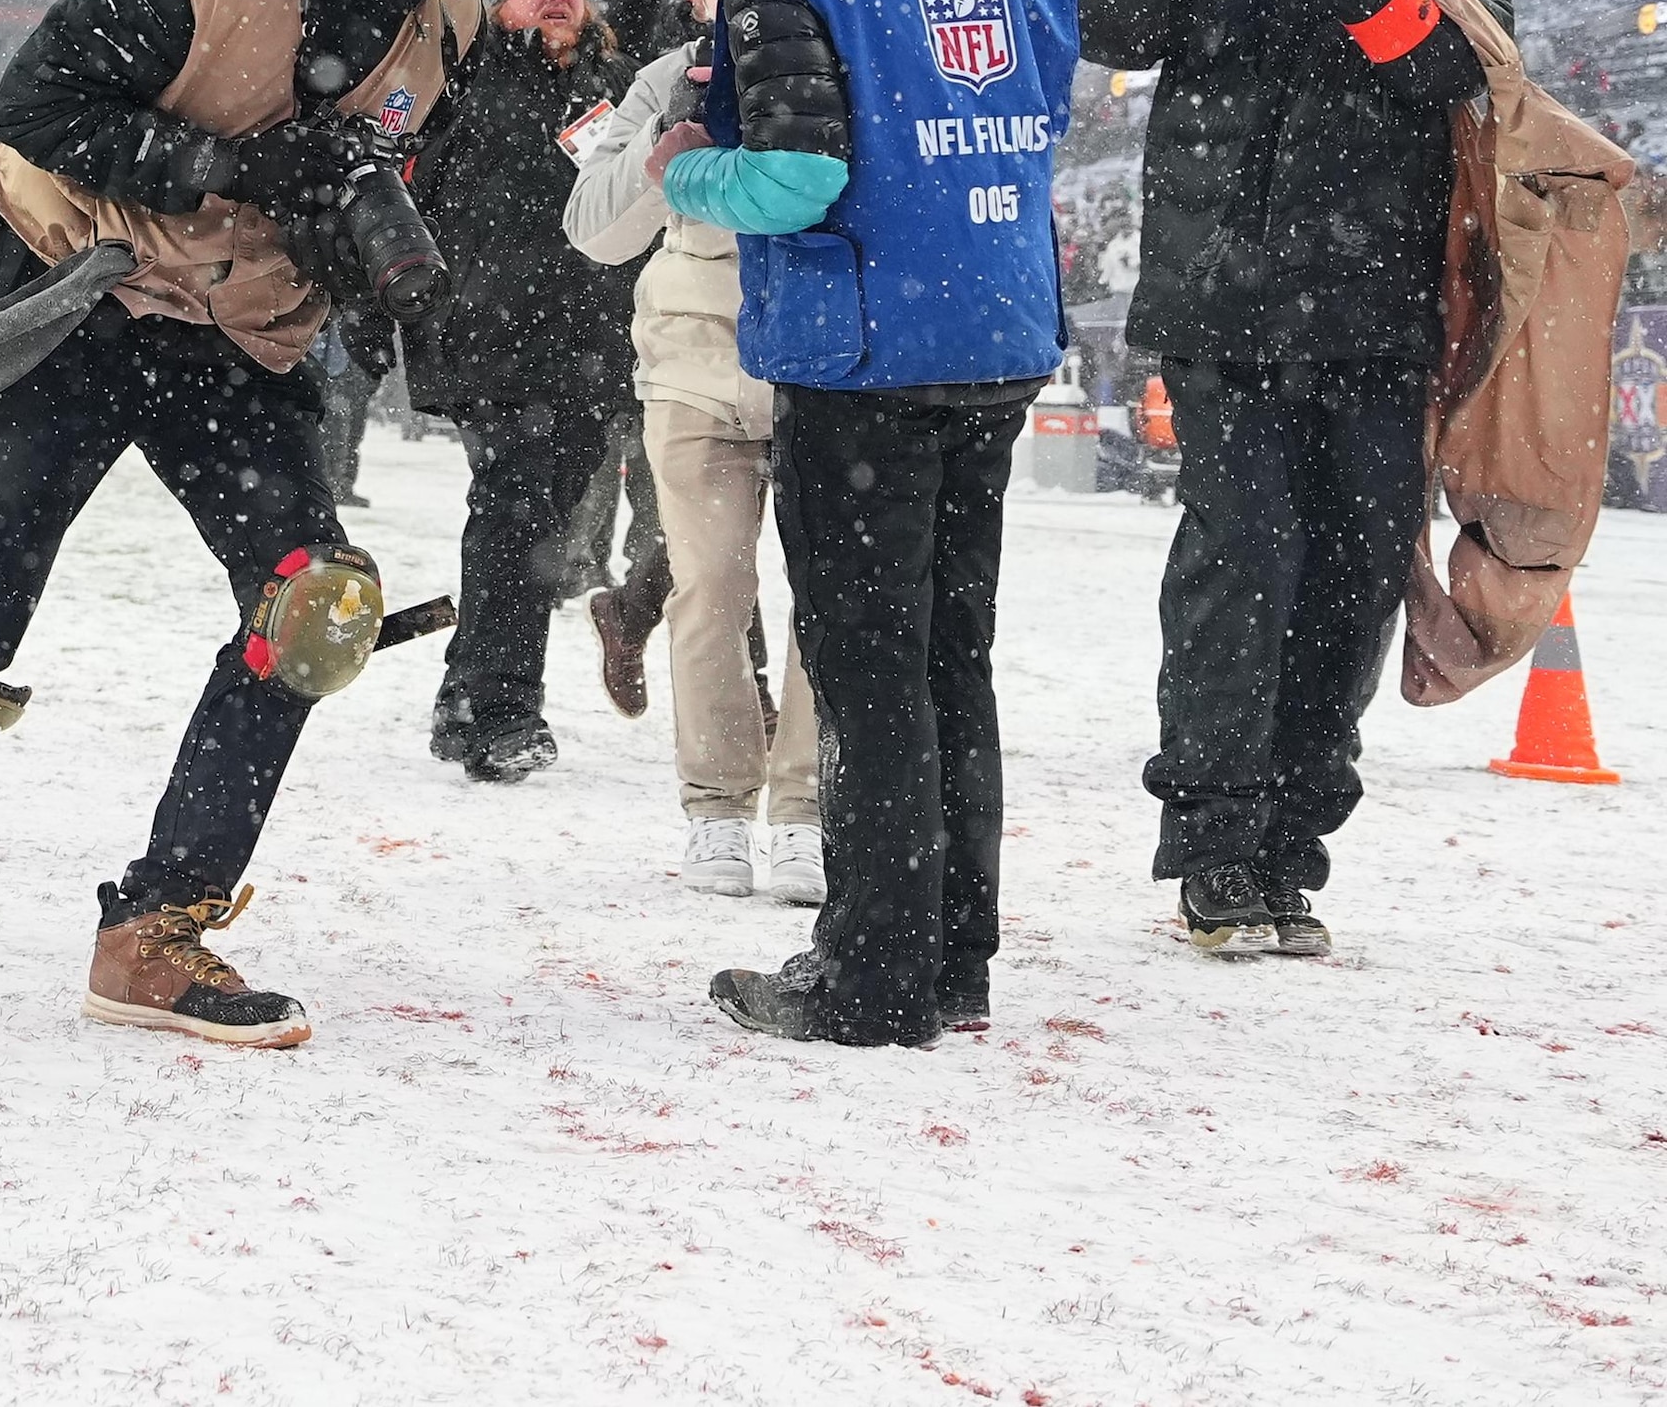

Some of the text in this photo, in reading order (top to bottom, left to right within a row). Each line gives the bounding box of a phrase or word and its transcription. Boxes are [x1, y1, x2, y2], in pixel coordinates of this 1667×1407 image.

[936, 24, 1006, 76] NFL
[380, 108, 404, 132] NFL
[916, 115, 1051, 157] NFL FILMS
[969, 184, 1019, 225] 005
